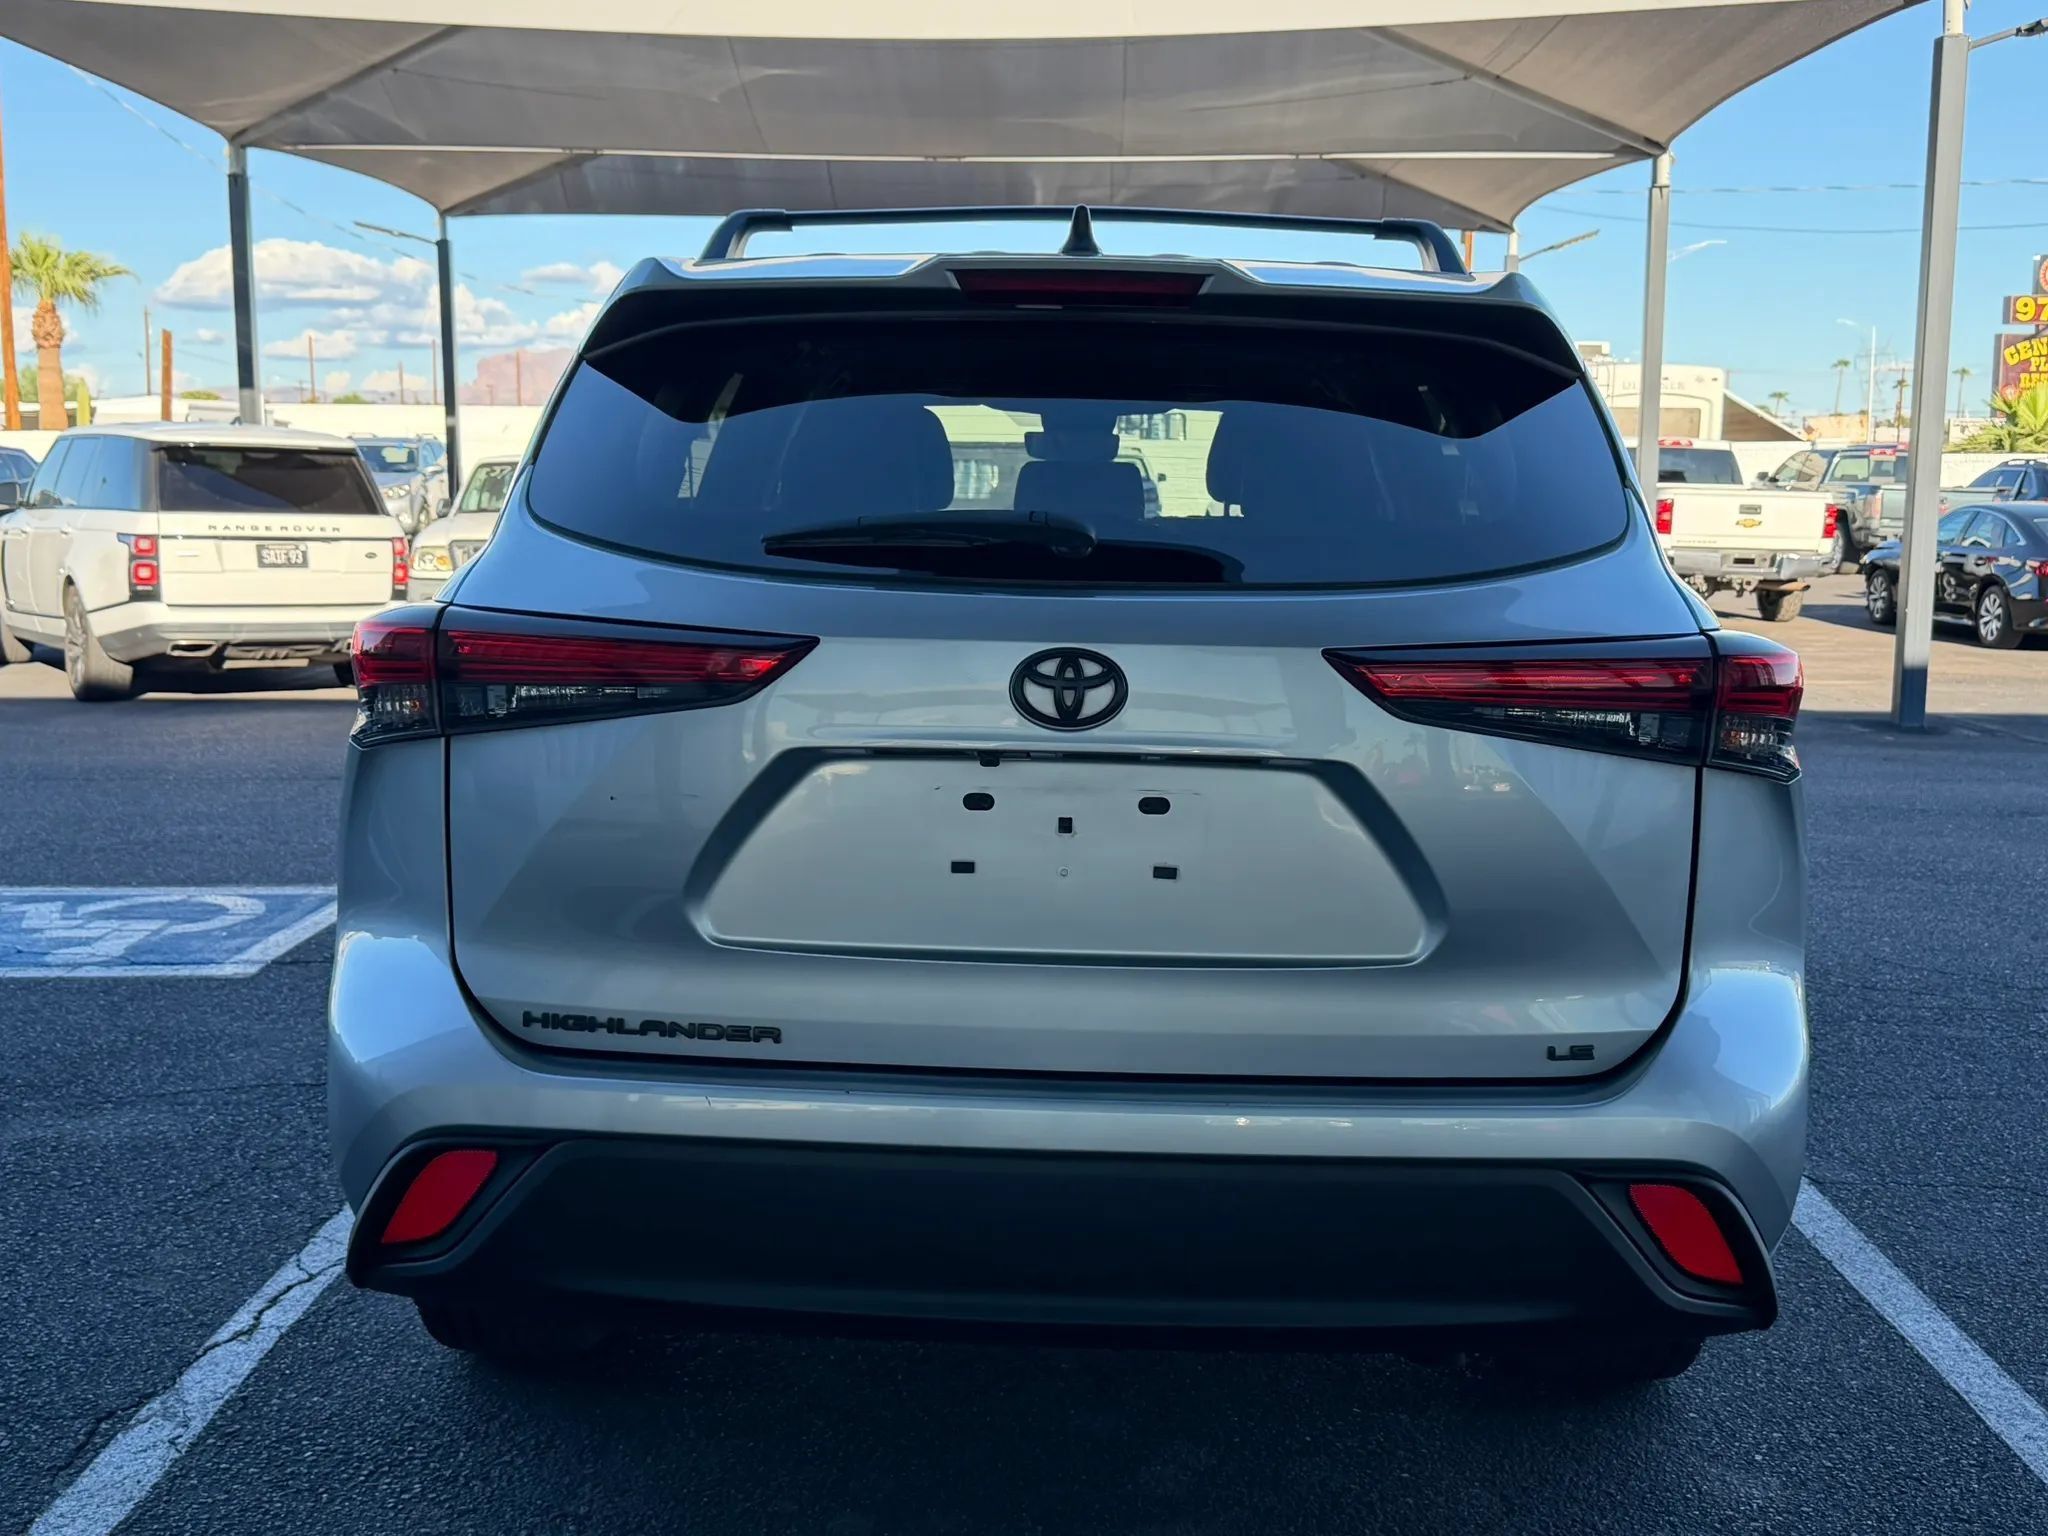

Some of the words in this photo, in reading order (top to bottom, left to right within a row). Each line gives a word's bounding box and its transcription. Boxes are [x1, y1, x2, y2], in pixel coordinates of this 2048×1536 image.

[208, 524, 272, 532] RANGE
[279, 525, 341, 533] ROVER
[522, 1010, 782, 1044] HIGHLANDER
[1547, 1045, 1595, 1061] LE
